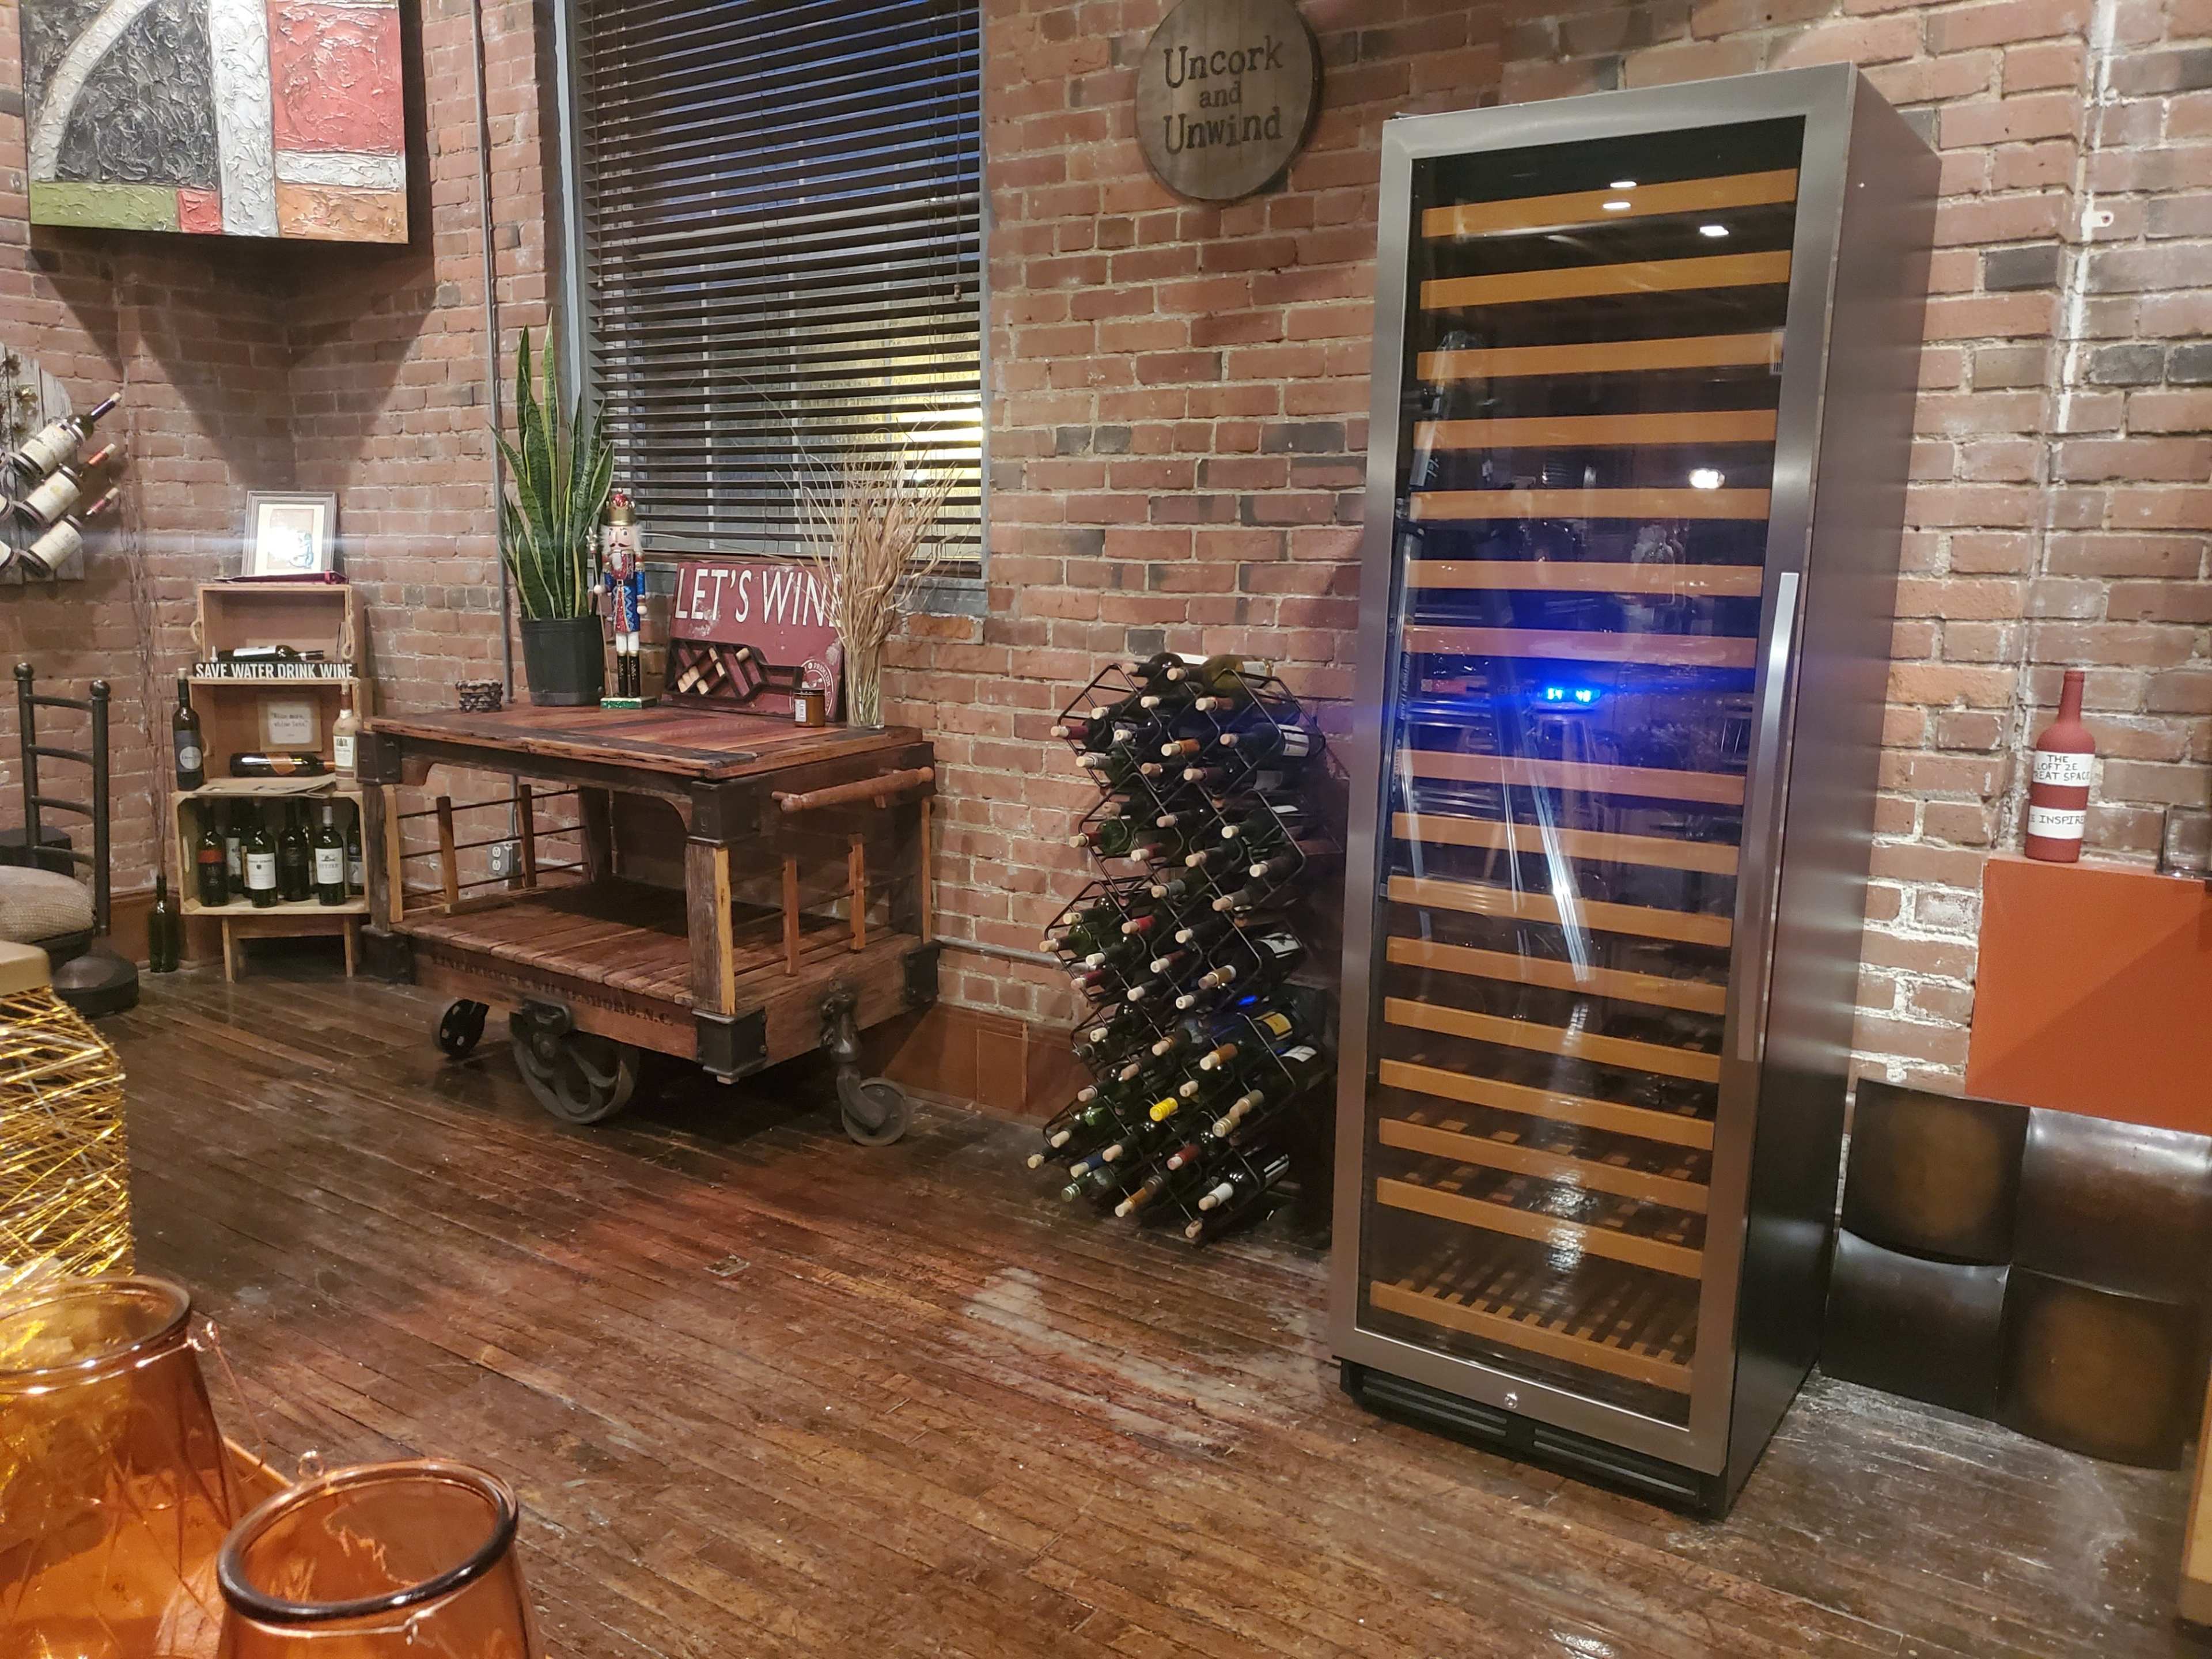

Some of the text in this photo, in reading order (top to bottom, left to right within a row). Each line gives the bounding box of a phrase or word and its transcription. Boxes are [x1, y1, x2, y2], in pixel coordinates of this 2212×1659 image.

[1164, 35, 1284, 89] Uncork
[1199, 81, 1243, 108] and
[1164, 106, 1284, 155] Unwind
[675, 568, 752, 623] LET'S
[196, 663, 353, 679] SAVE WATER DRINK WINE
[2037, 762, 2061, 771] LOFT
[2047, 755, 2069, 763] THE
